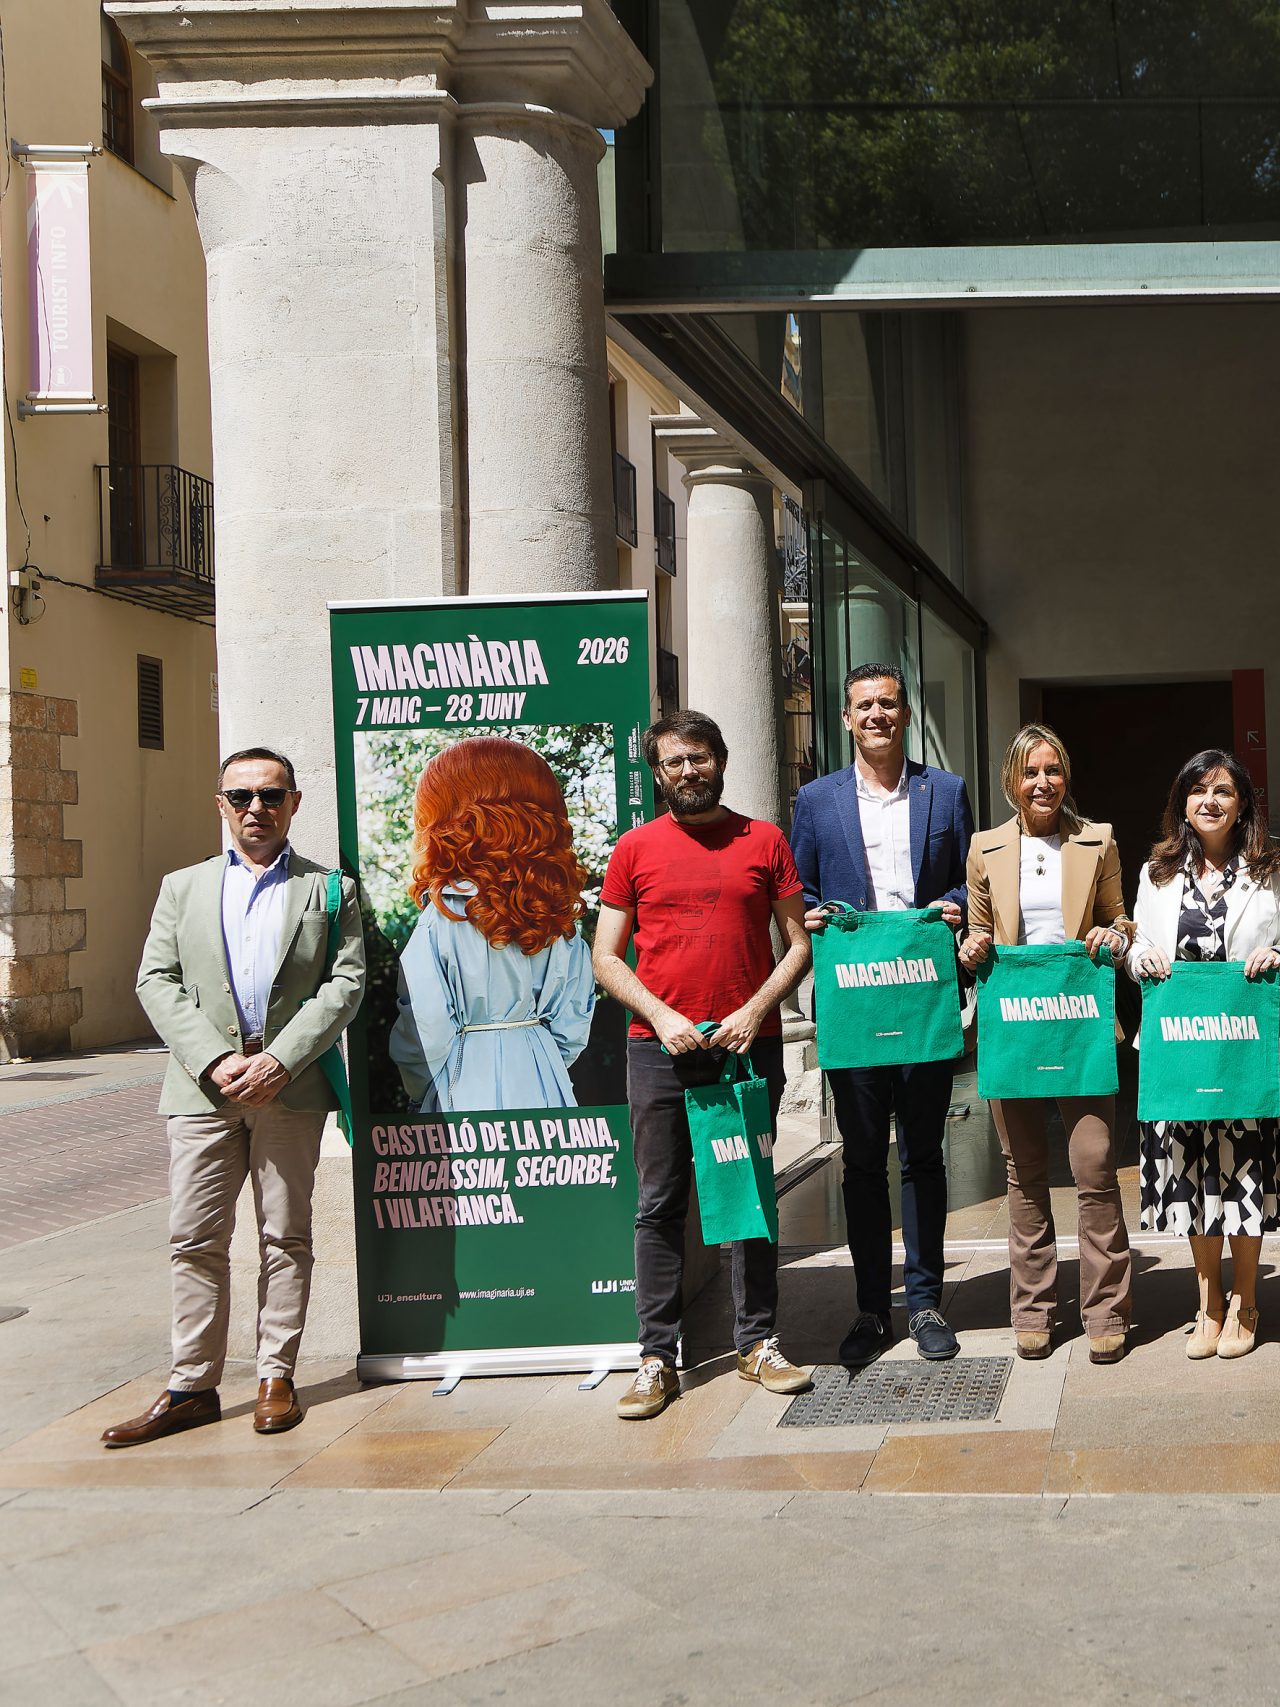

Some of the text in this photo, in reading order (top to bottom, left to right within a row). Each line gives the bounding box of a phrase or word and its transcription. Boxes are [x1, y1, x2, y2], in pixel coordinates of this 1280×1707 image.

[50, 225, 67, 270] INFO
[52, 275, 69, 352] TOURIST
[350, 635, 549, 691] IMAGINÀRIA
[577, 637, 629, 664] 2026
[356, 698, 368, 725] 7
[371, 696, 421, 724] MAIG
[445, 694, 473, 722] 28
[476, 692, 526, 721] JUNY
[835, 955, 938, 989] IMAGINÀRIA
[999, 992, 1100, 1022] IMAGINÀRIA
[1160, 1013, 1259, 1042] IMAGINÀRIA
[372, 1117, 619, 1156] CASTELLÓ DE LA PLANA,
[373, 1153, 617, 1193] BENICÀSSIM, SEGORBE,
[372, 1194, 524, 1229] I VILAFRANCA.
[378, 1292, 442, 1303] UJI_encultura
[459, 1287, 535, 1300] www.imaginaria.uji.es
[592, 1280, 617, 1294] UJI
